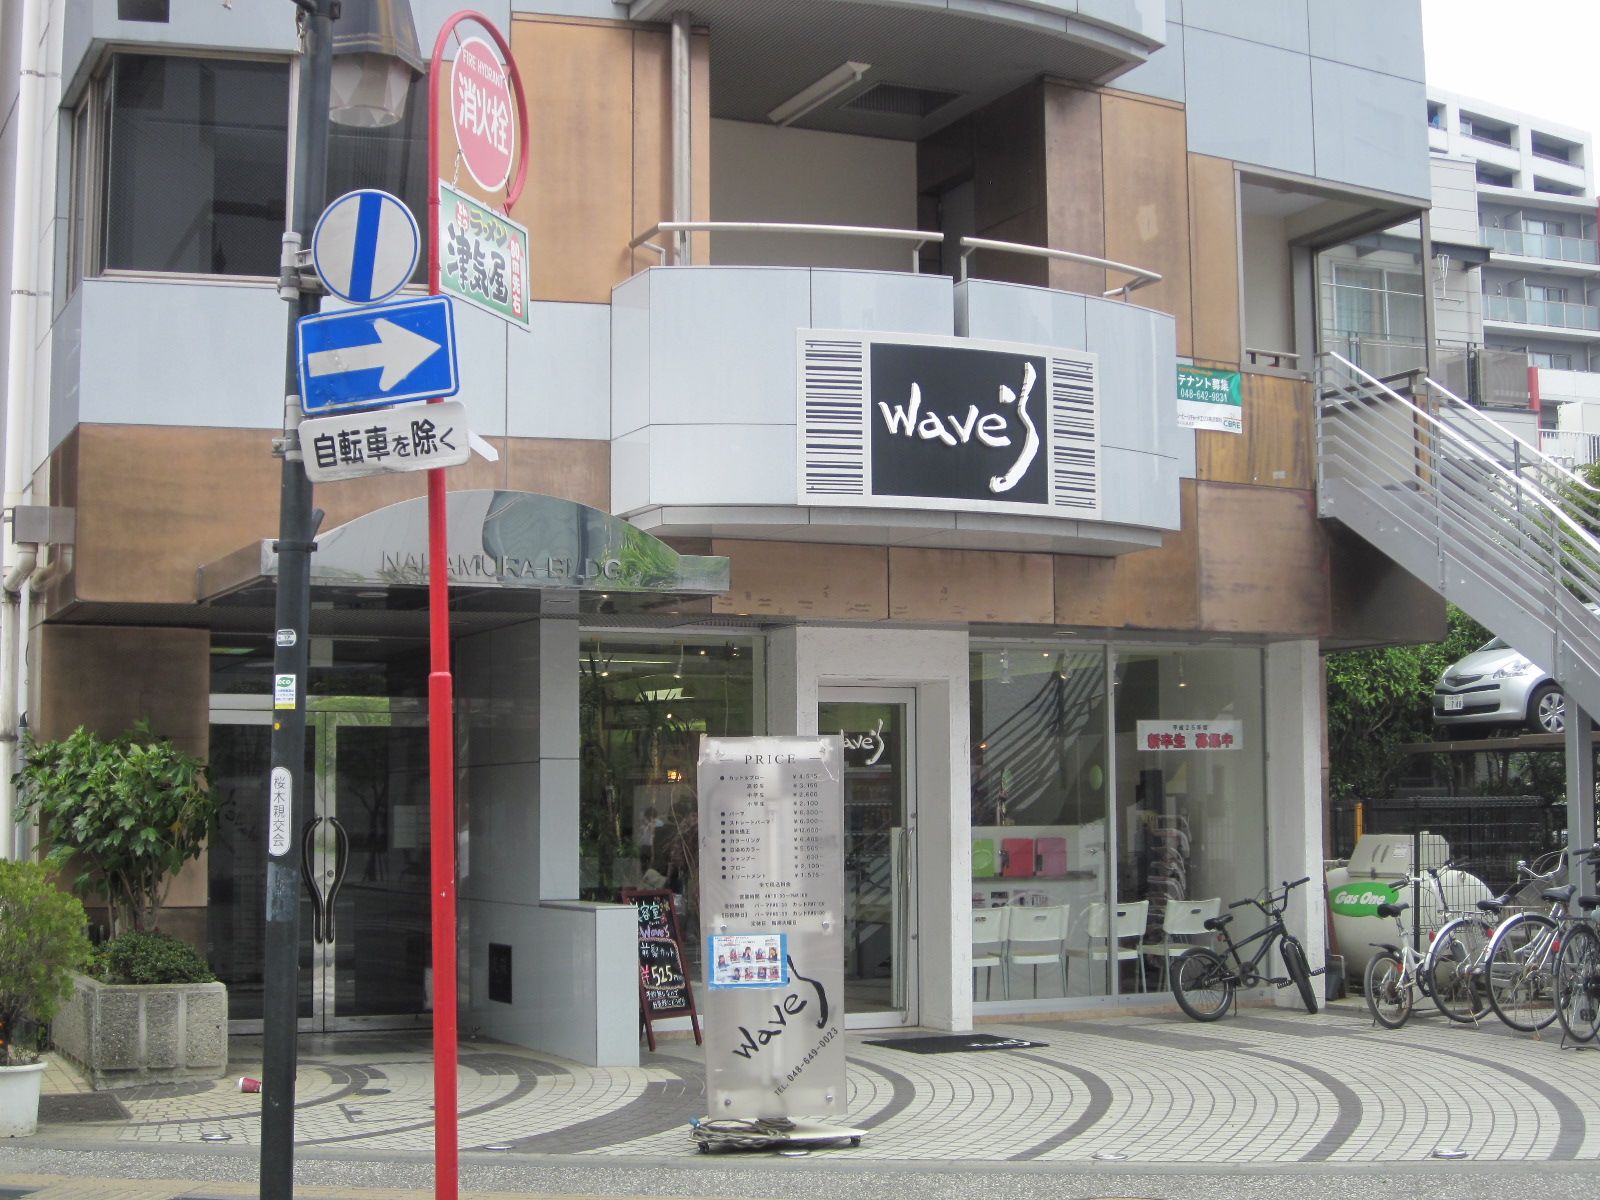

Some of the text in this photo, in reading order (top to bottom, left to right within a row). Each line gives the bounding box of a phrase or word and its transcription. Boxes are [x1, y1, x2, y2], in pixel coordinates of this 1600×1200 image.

[462, 48, 505, 89] FIRE HYDRANT
[458, 71, 510, 156] 消火栓
[446, 221, 509, 305] 津気屋
[1177, 374, 1229, 392] テナント募集
[313, 418, 456, 469] 自転車を除く
[744, 754, 797, 765] PRICE
[1147, 732, 1187, 750] 新卒生
[273, 776, 285, 848] 桜木親交会
[1334, 890, 1386, 905] Gas One
[787, 1026, 839, 1083] 048-649-0023
